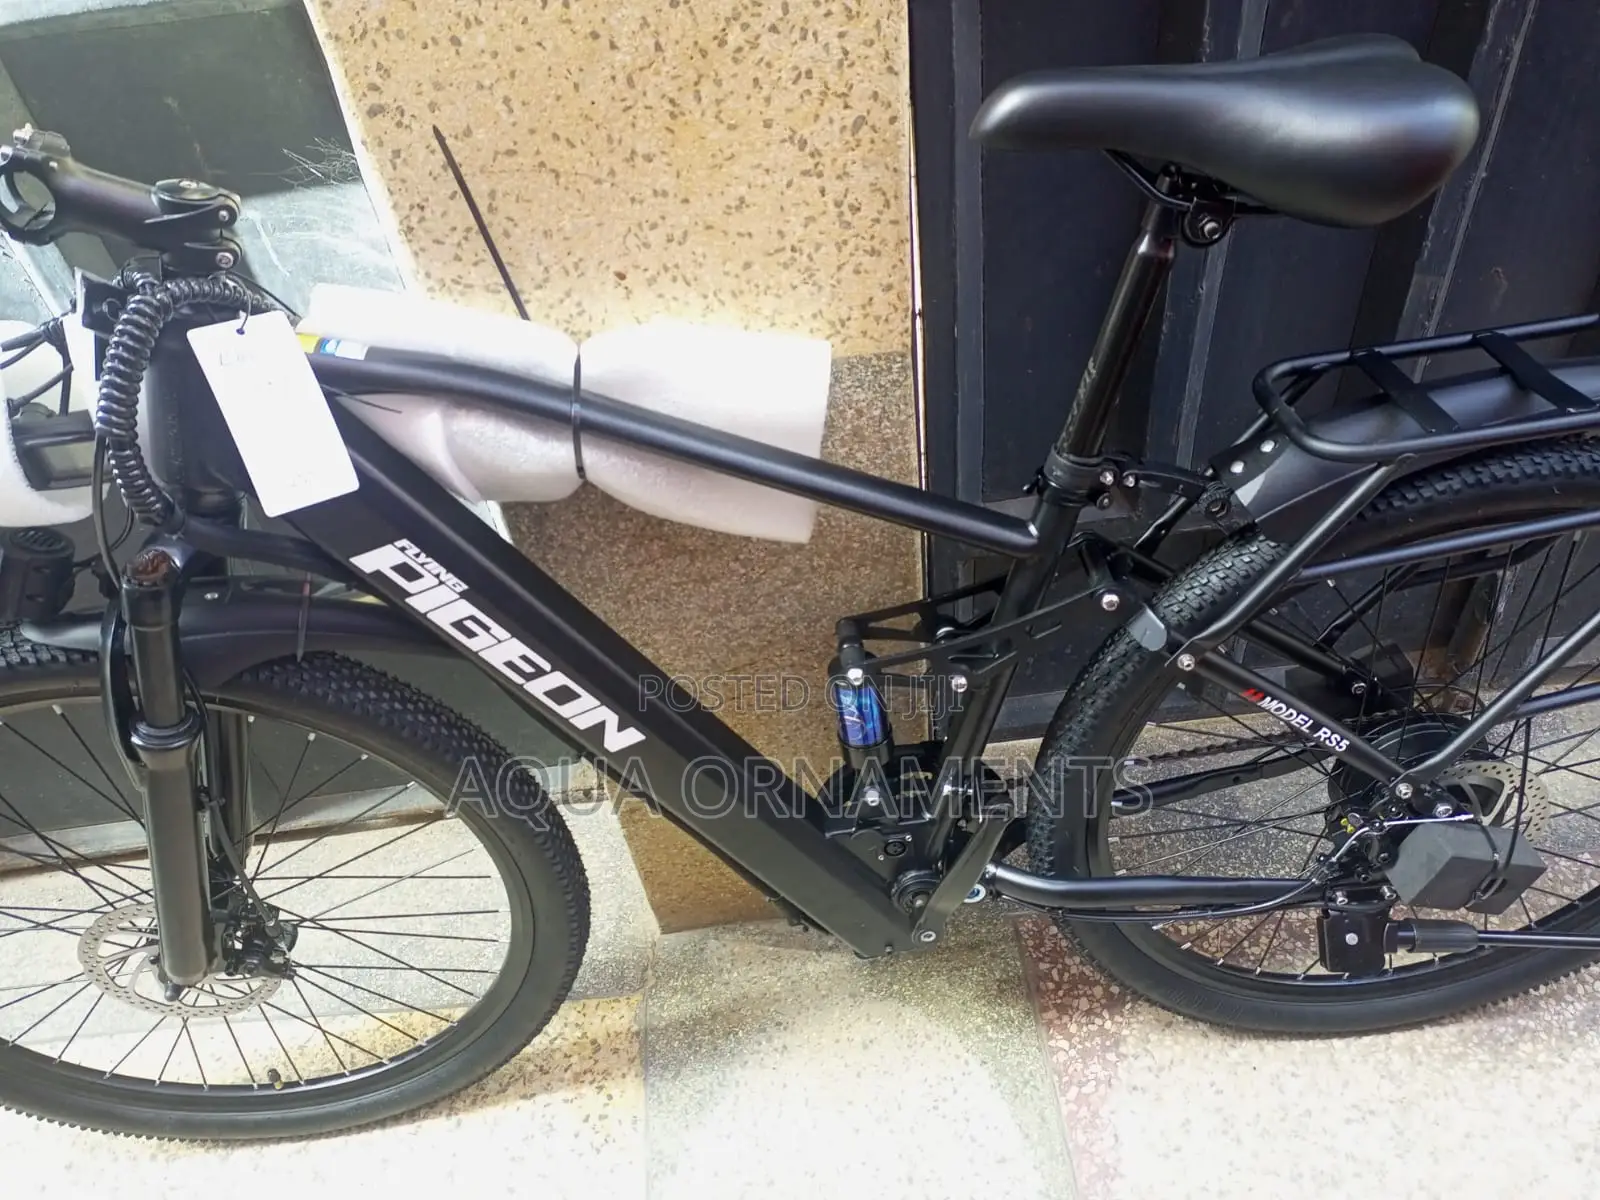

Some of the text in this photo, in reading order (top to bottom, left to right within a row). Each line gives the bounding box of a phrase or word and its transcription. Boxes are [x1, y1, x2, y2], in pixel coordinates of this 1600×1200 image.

[393, 538, 470, 593] FLYING
[349, 544, 646, 753] PIGEON
[1258, 696, 1314, 733] MODEL
